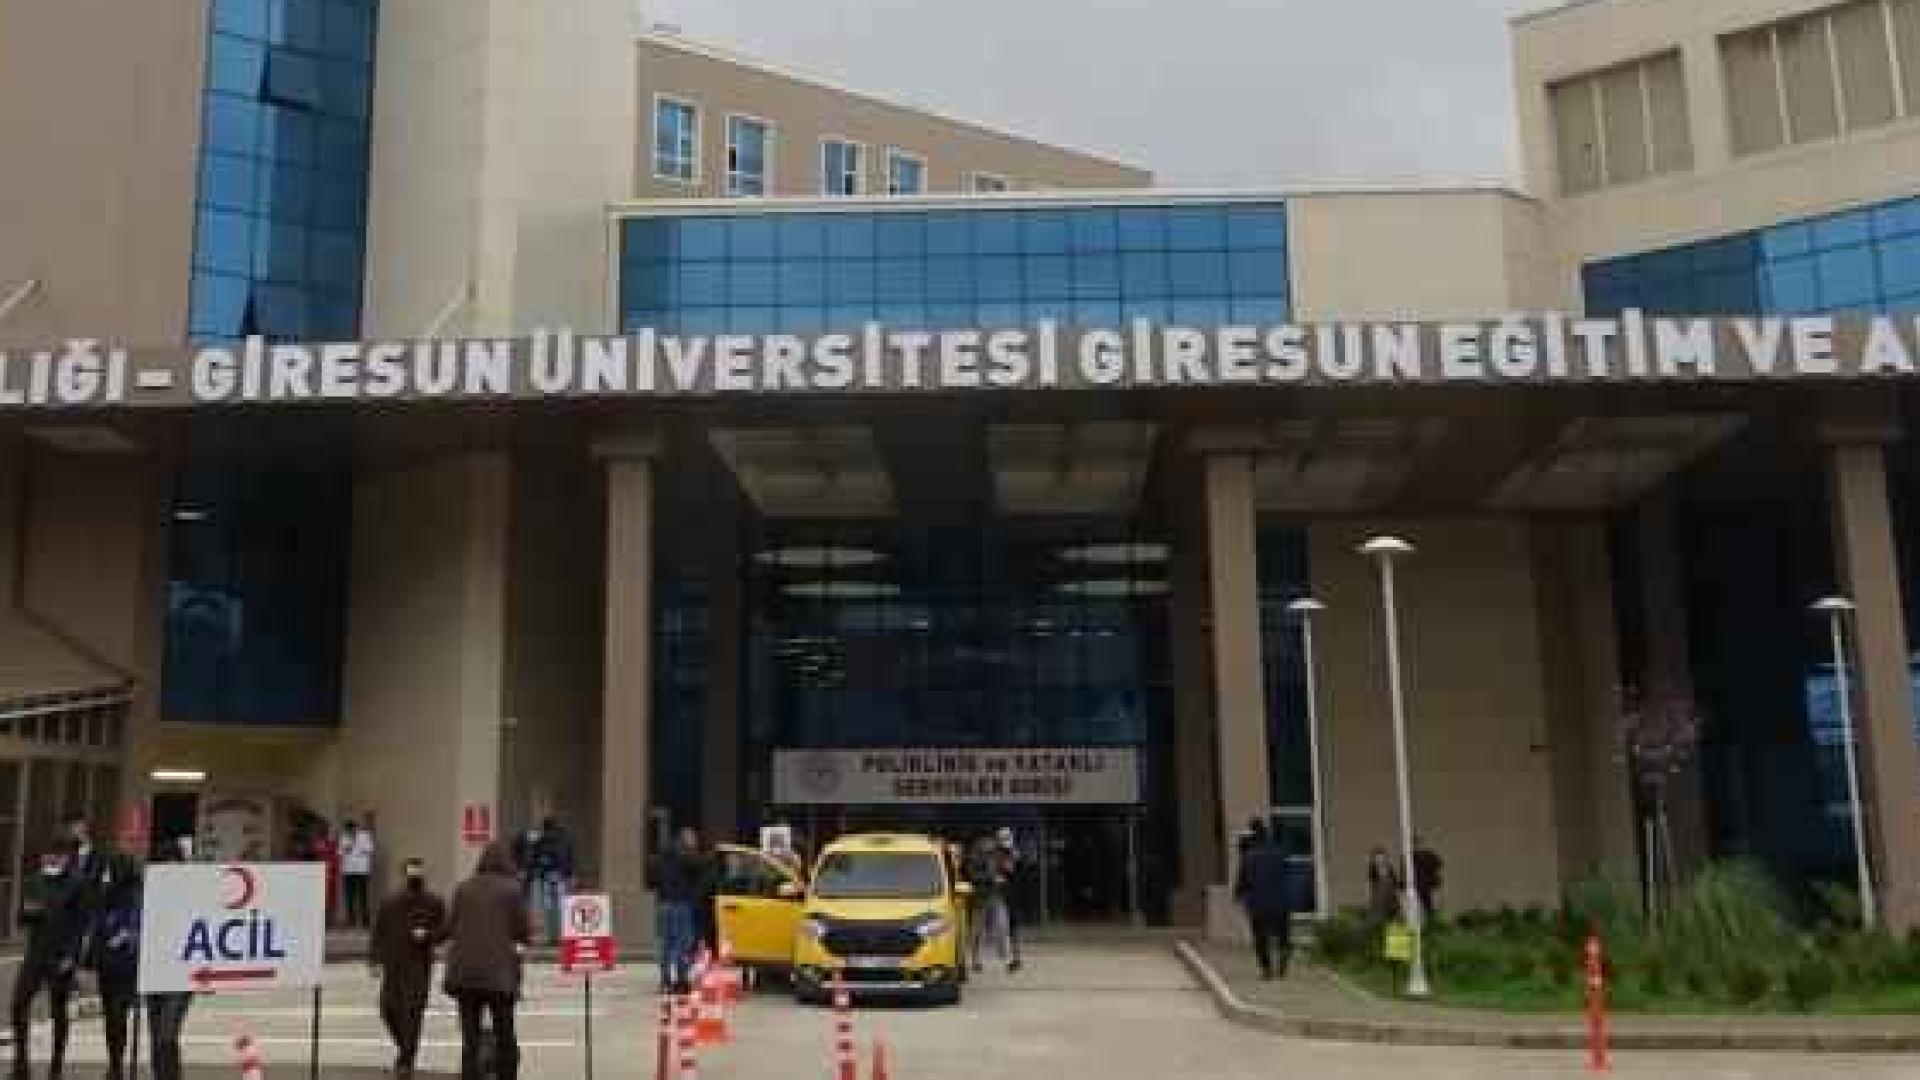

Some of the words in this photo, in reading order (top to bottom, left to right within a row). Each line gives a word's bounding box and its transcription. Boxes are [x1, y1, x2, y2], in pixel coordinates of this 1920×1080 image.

[191, 334, 512, 401] GİRESUN
[530, 317, 1059, 392] ÜNİVERSİTESİ
[1081, 316, 1421, 387] GİRESUN
[1440, 308, 1716, 379] EĞİTİM
[1731, 317, 1837, 373] VE
[1861, 316, 1920, 373] A
[183, 908, 287, 961] ACİL
